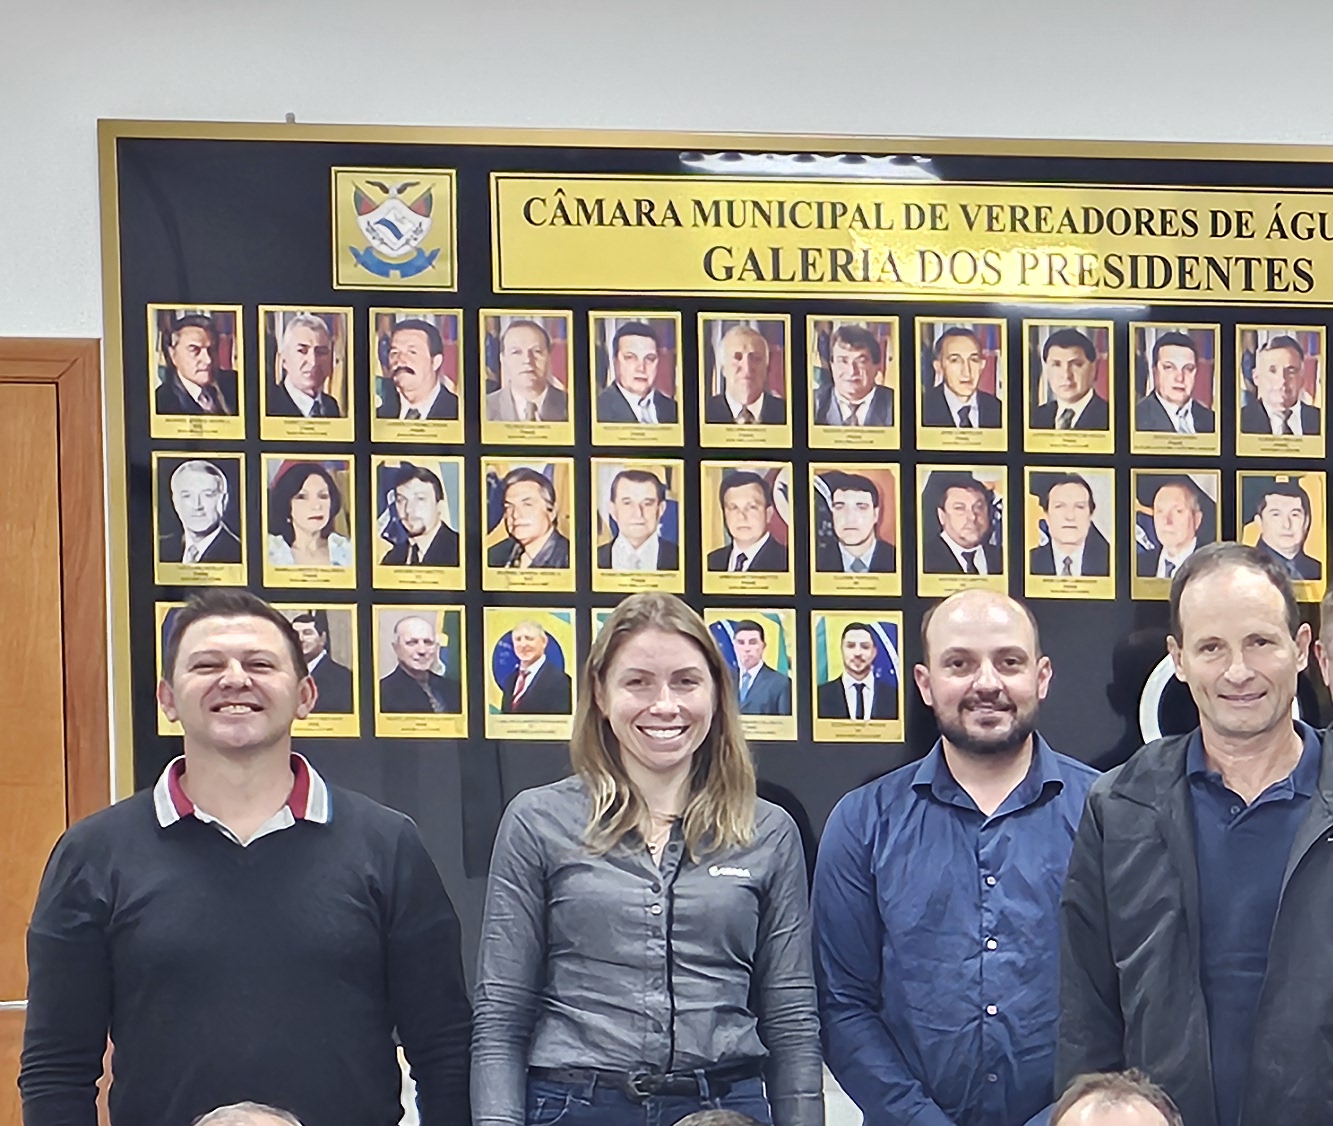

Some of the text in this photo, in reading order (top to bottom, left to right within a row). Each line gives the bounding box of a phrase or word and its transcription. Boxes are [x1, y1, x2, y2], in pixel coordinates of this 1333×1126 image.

[523, 188, 682, 228] CÂMARA
[691, 197, 893, 231] MUNICIPAL
[904, 203, 949, 231] DE
[959, 204, 1198, 238] VEREADORES
[1209, 209, 1255, 240] DE
[703, 245, 1314, 293] GALERIA DOS PRESIDENTES
